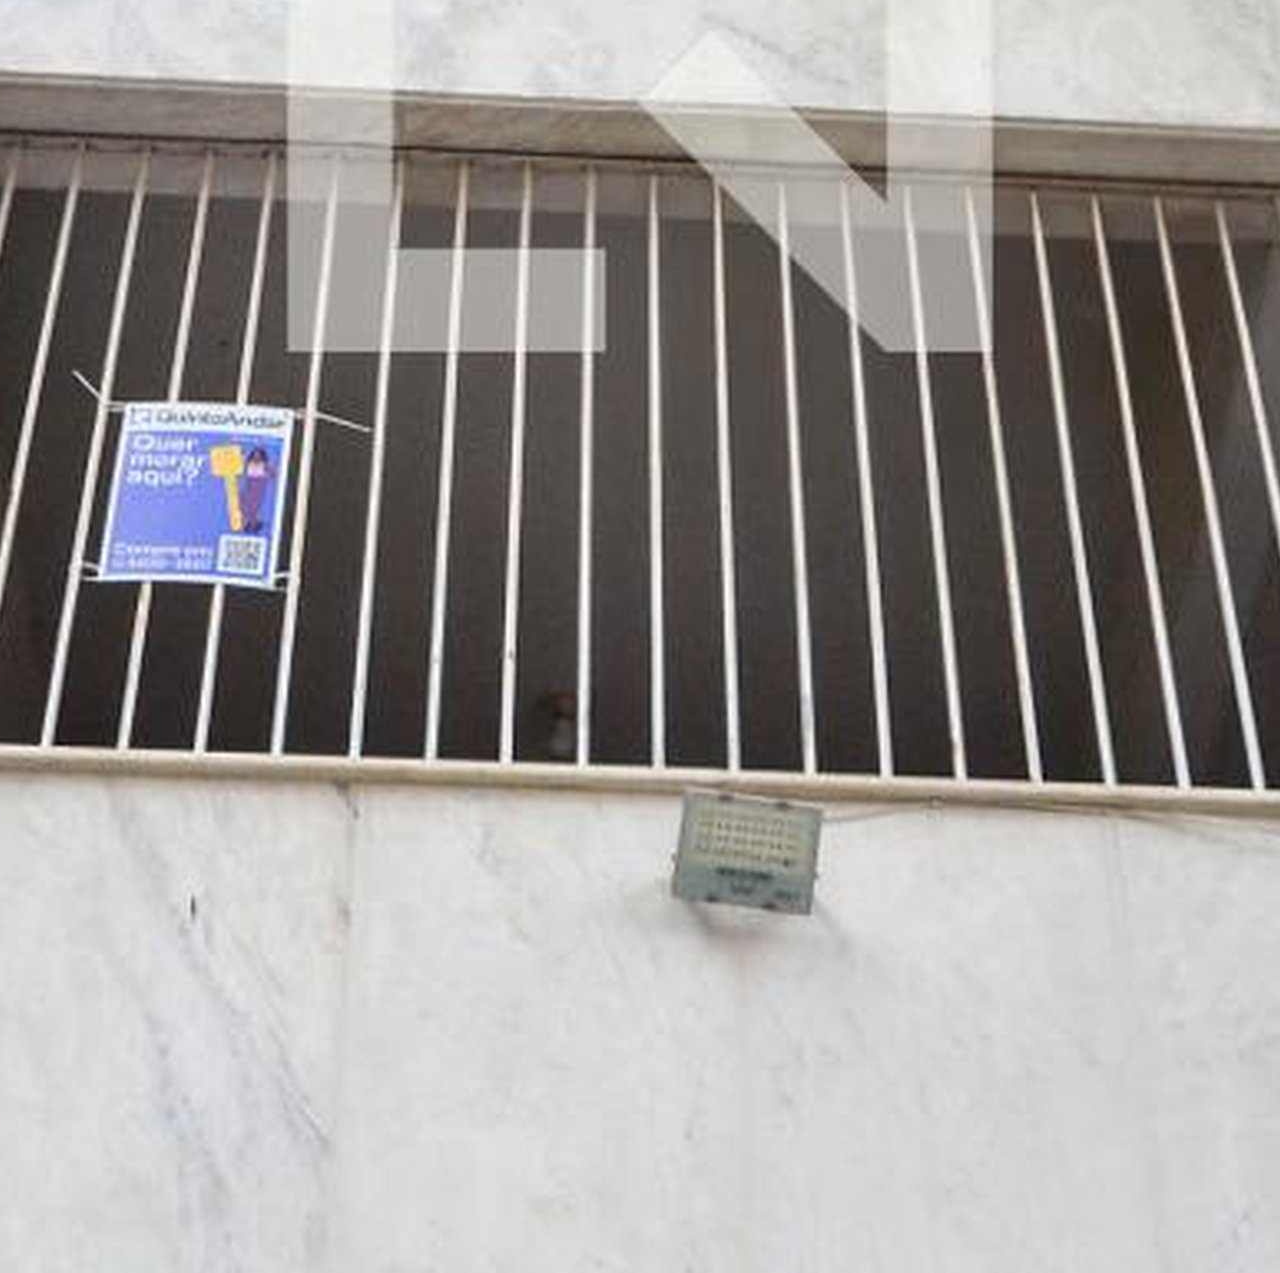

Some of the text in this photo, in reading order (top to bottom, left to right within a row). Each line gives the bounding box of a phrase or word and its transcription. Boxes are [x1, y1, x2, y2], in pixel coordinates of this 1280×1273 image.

[132, 434, 199, 452] Quer
[129, 453, 204, 468] morar
[126, 467, 199, 488] aqui?
